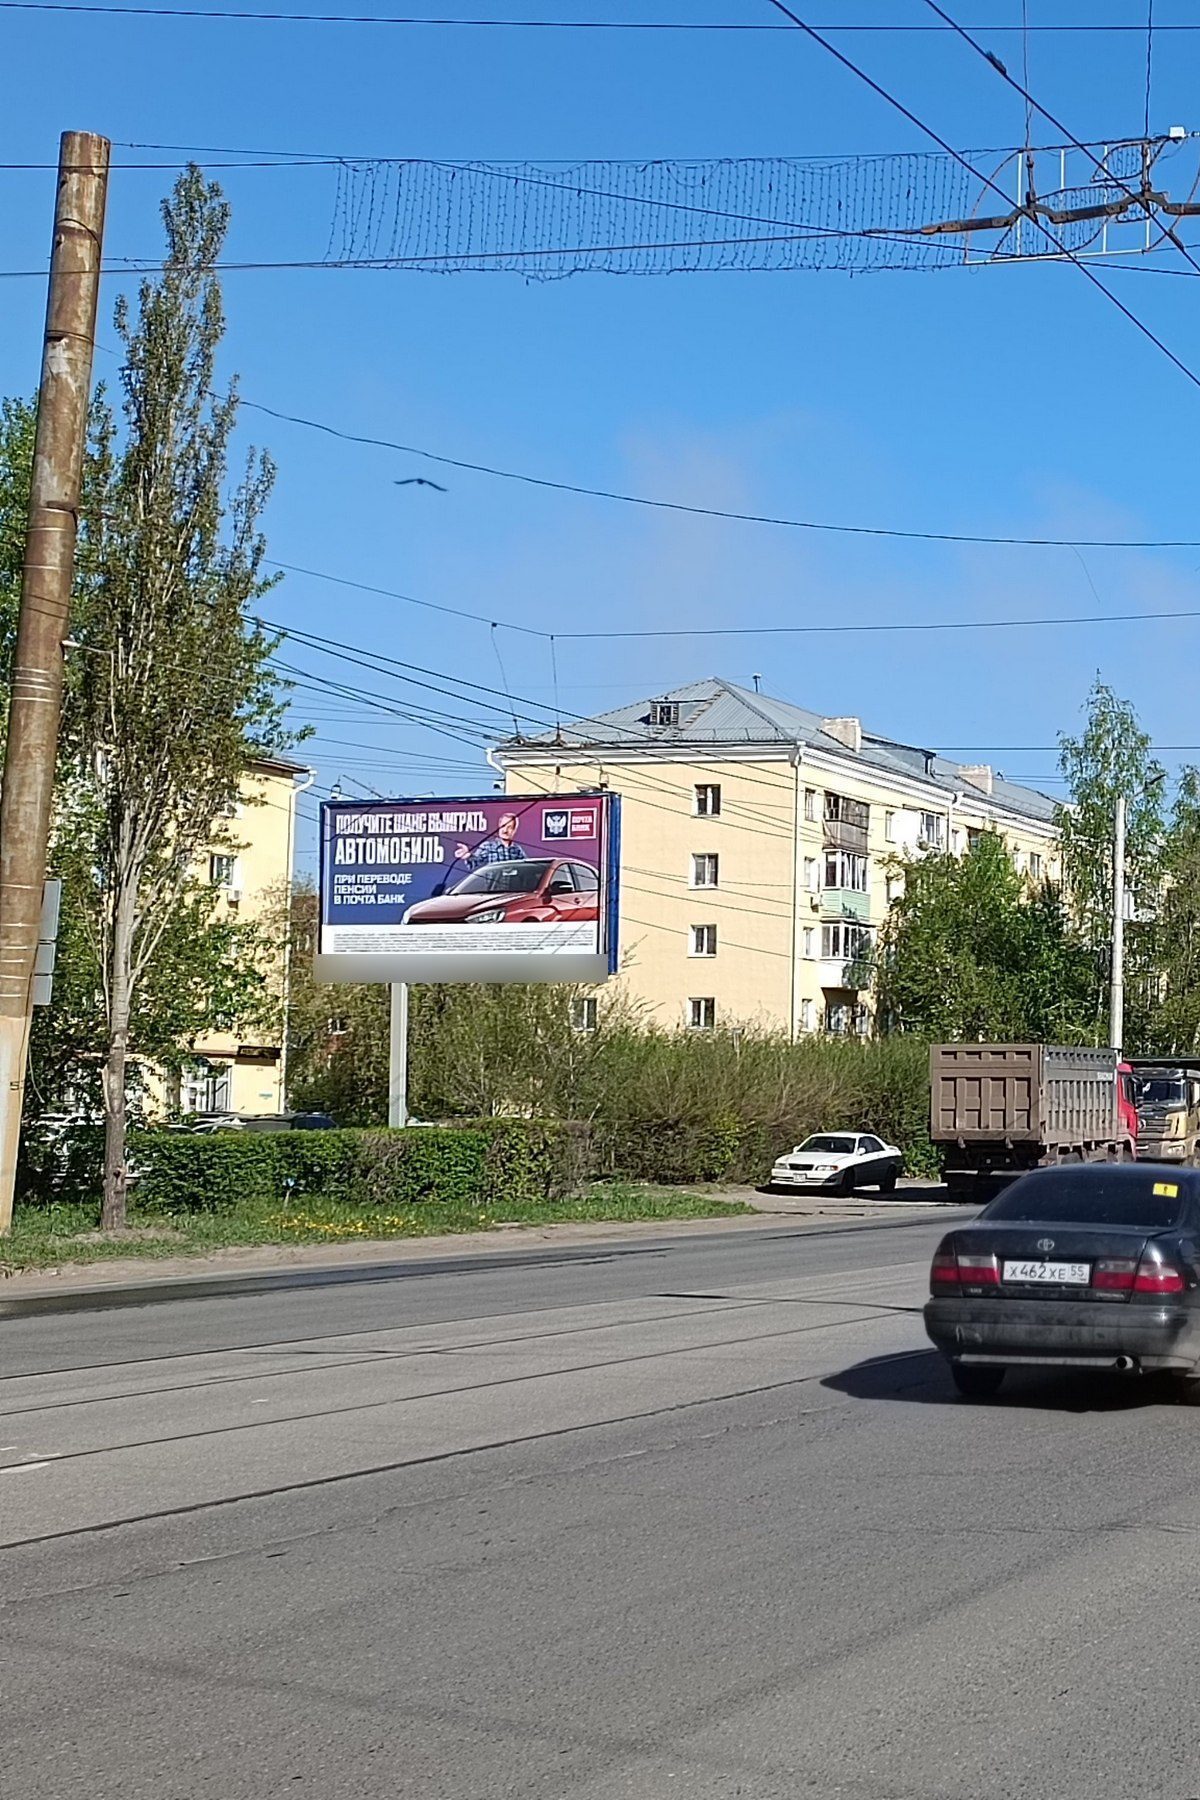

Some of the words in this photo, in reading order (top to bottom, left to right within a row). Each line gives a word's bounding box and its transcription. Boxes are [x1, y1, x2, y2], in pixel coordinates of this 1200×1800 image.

[336, 813, 393, 834] ПОЛУЧИТЕ
[394, 812, 427, 833] ШАНС
[428, 811, 487, 832] ВЫИГРАТЬ
[335, 836, 444, 865] АВТОМОБИЛЬ
[334, 874, 356, 884] ПРИ
[357, 873, 412, 885] ПЕРЕВОДЕ
[334, 884, 377, 894] ПЕНСИИ
[334, 895, 341, 905] В
[343, 894, 377, 905] ПОЧТА
[378, 893, 405, 904] БАНК
